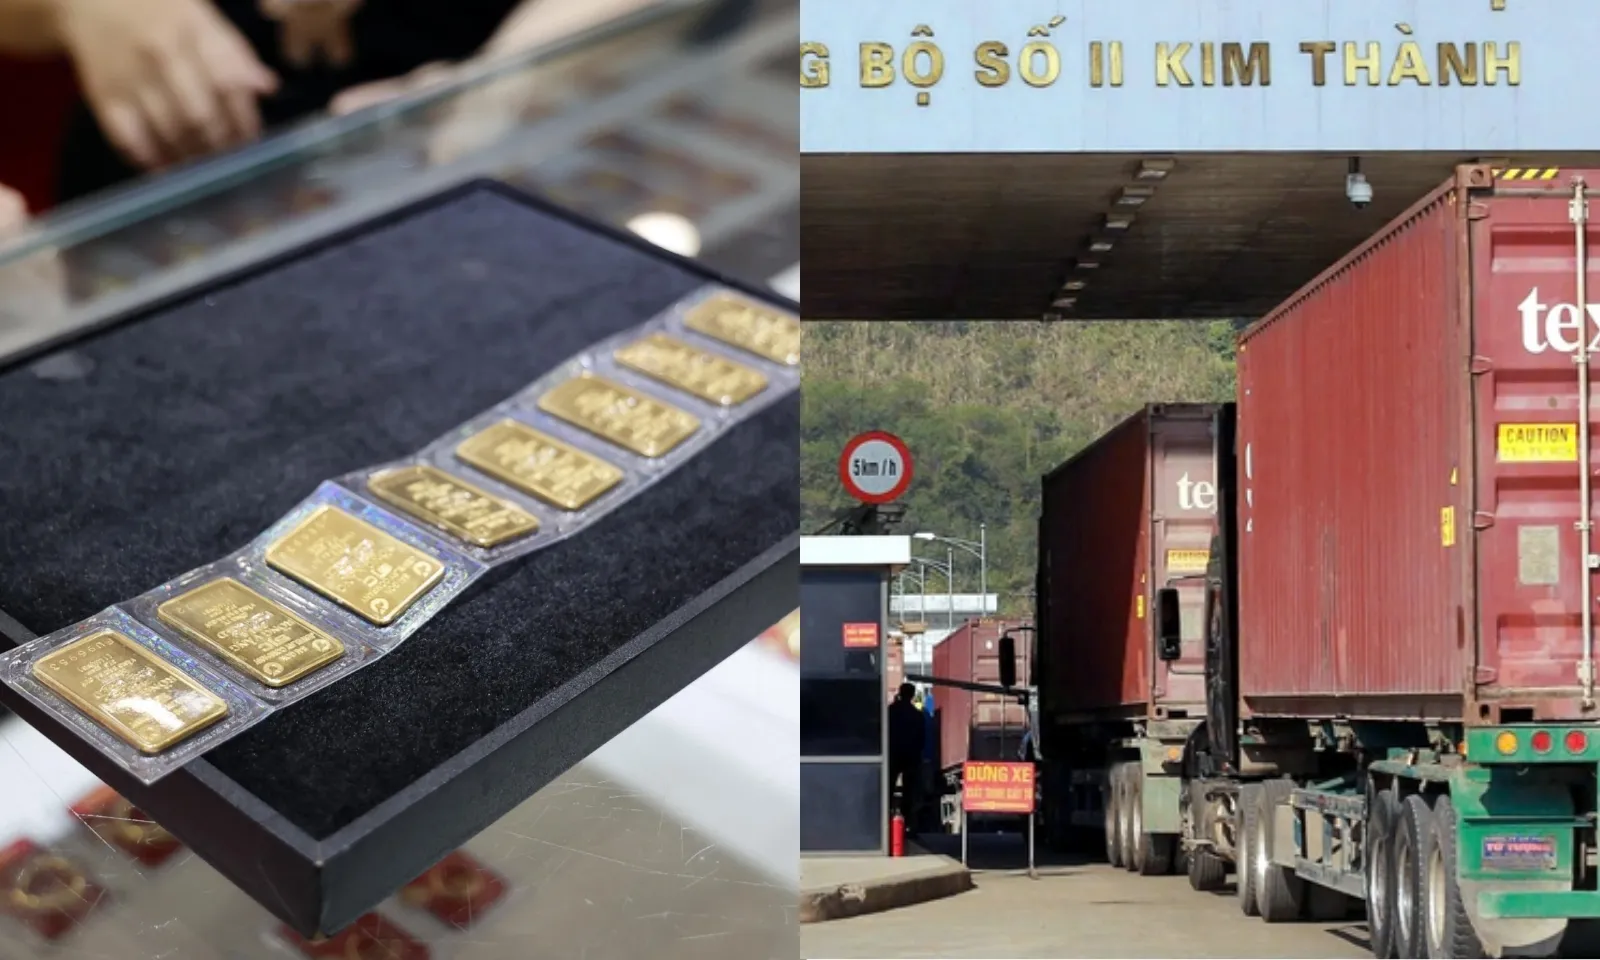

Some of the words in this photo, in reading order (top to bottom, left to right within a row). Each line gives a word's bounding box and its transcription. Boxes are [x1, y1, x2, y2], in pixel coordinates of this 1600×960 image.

[859, 24, 945, 107] BỘ
[974, 15, 1067, 89] SỐ
[1089, 41, 1124, 88] II
[1155, 41, 1271, 88] KIM
[1300, 23, 1521, 87] THÀNH
[1506, 427, 1568, 444] CAUTION
[1012, 766, 1030, 782] XE
